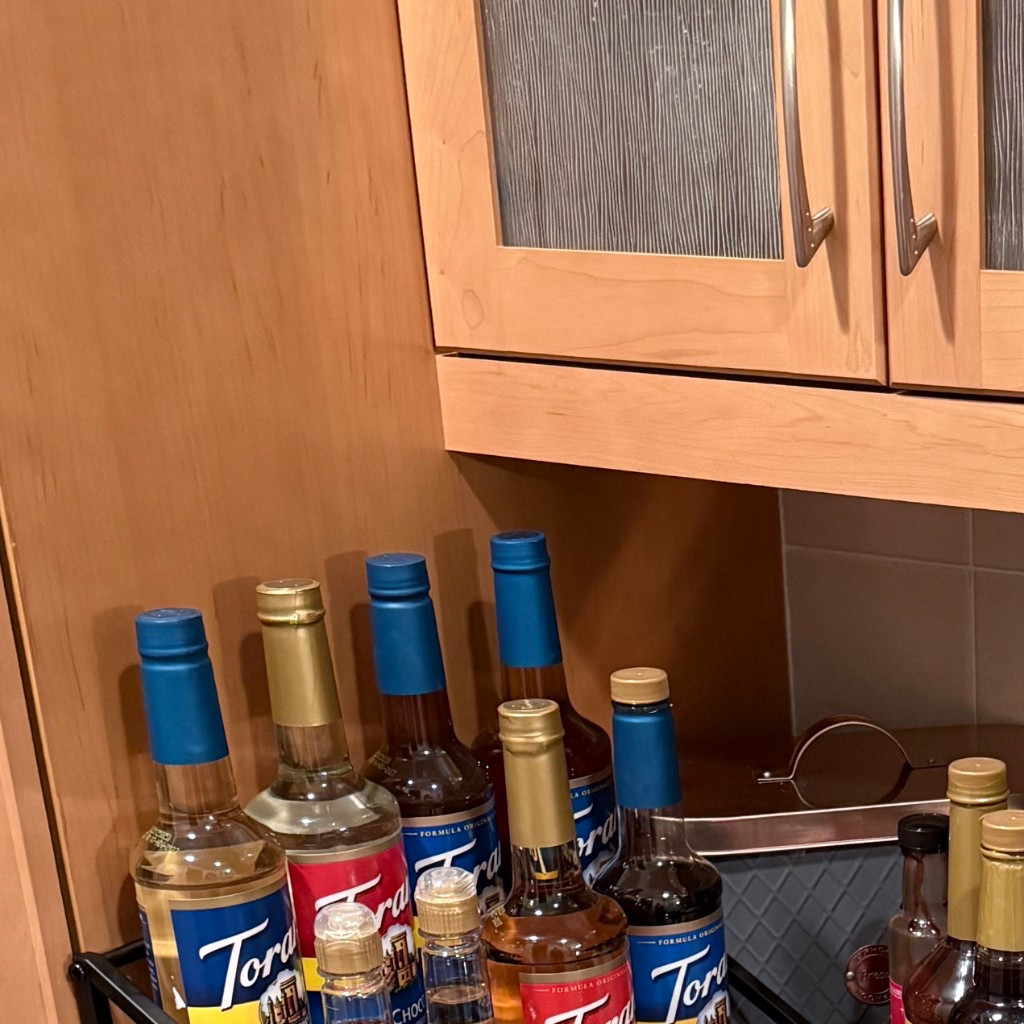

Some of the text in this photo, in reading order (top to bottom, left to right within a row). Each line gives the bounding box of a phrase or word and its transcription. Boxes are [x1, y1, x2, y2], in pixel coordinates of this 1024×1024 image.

[420, 826, 462, 838] FORMULA
[658, 934, 697, 946] FORMULA
[551, 982, 594, 994] FORMULA
